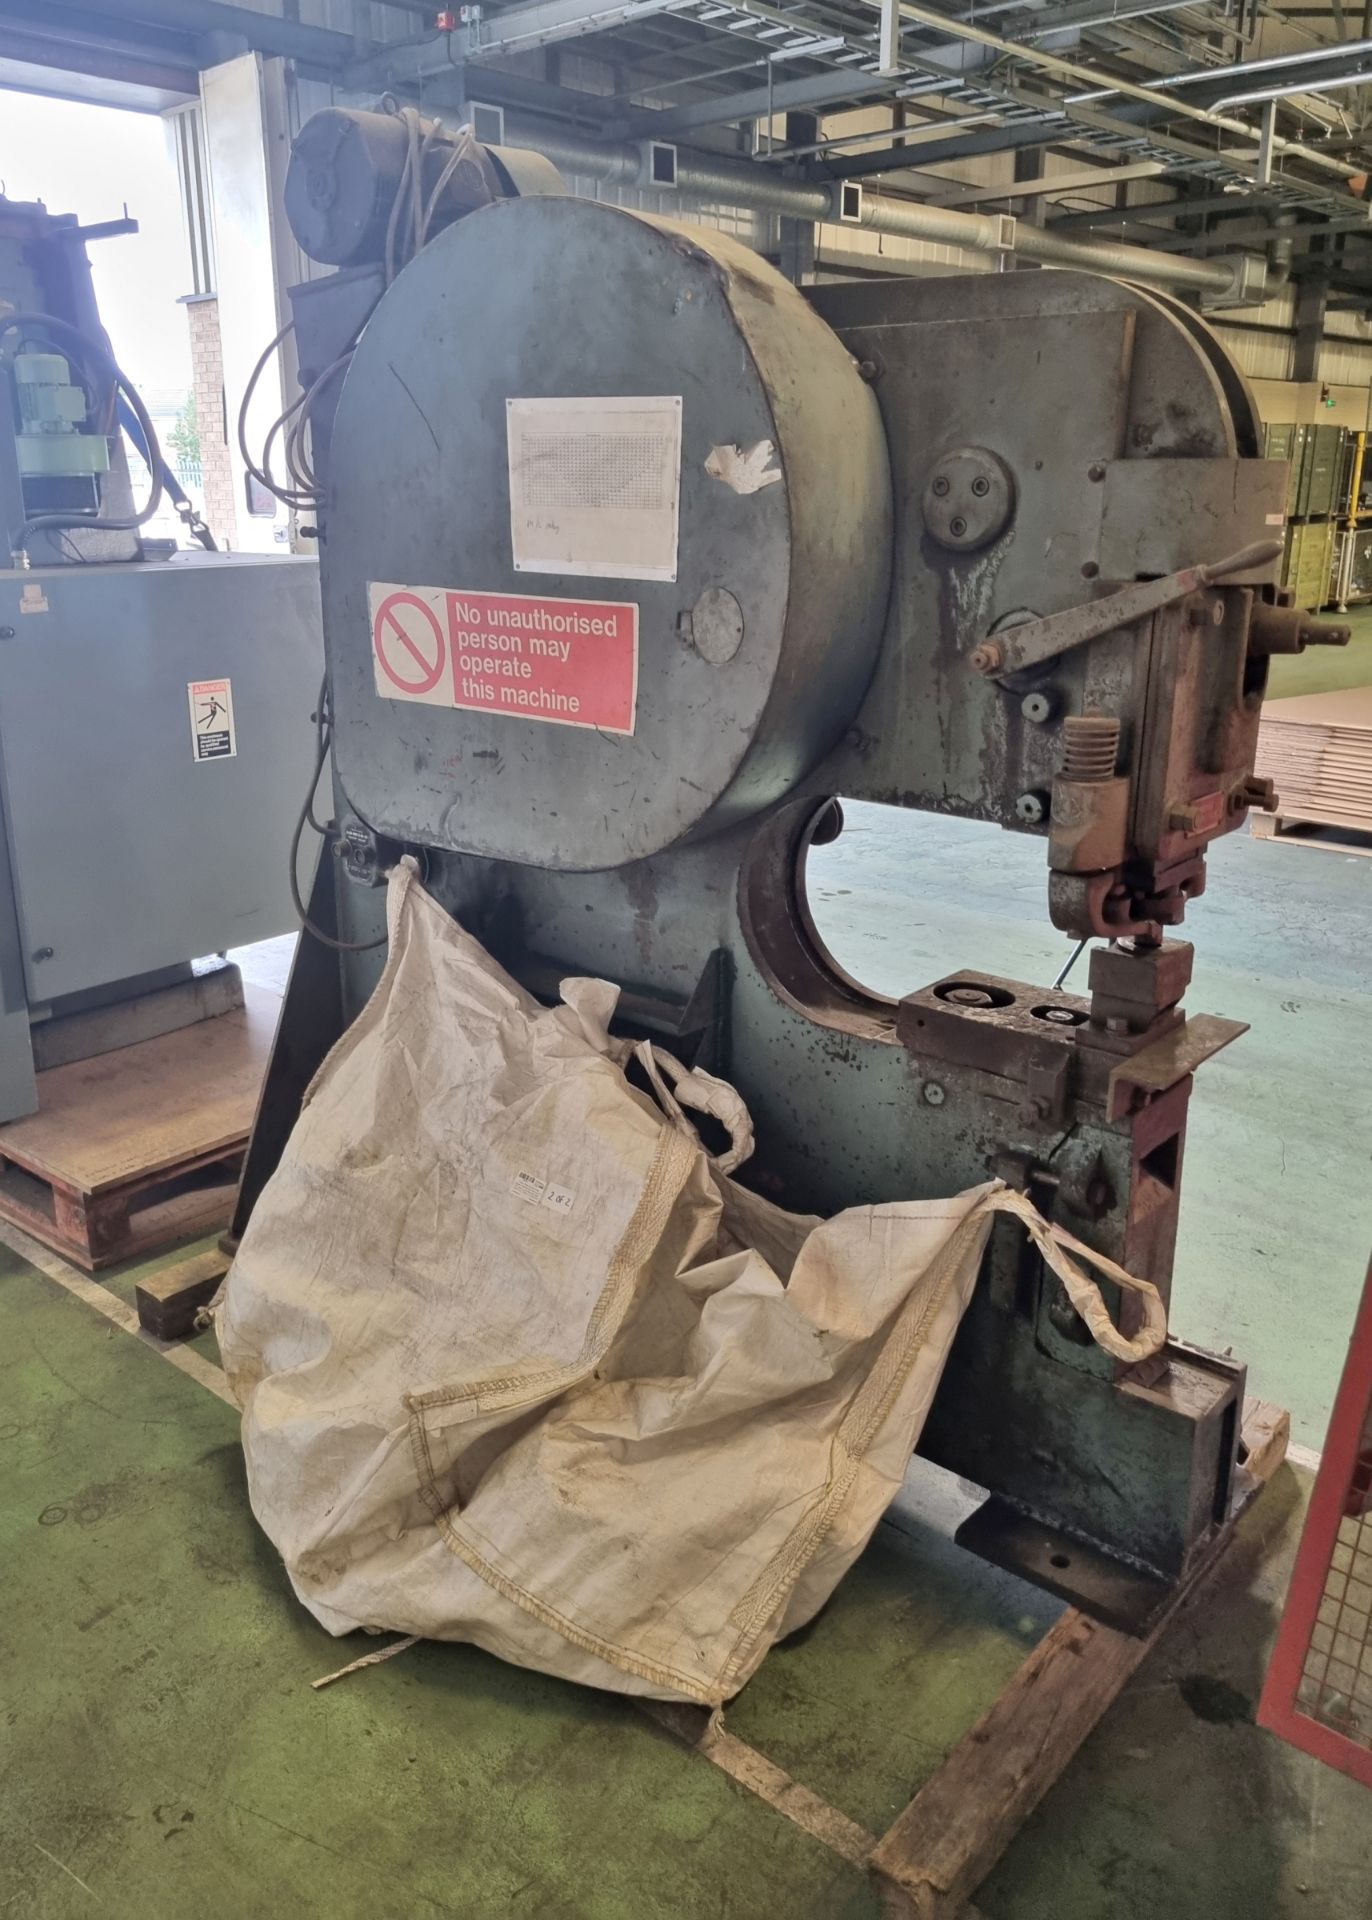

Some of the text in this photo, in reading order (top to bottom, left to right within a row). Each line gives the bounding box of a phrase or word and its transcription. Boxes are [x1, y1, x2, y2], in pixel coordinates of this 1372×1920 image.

[455, 602, 618, 637] No unauthorised
[458, 631, 571, 662] person may
[460, 653, 532, 679] operate
[462, 677, 580, 713] this machine
[547, 1191, 555, 1201] 2
[564, 1198, 571, 1208] 2
